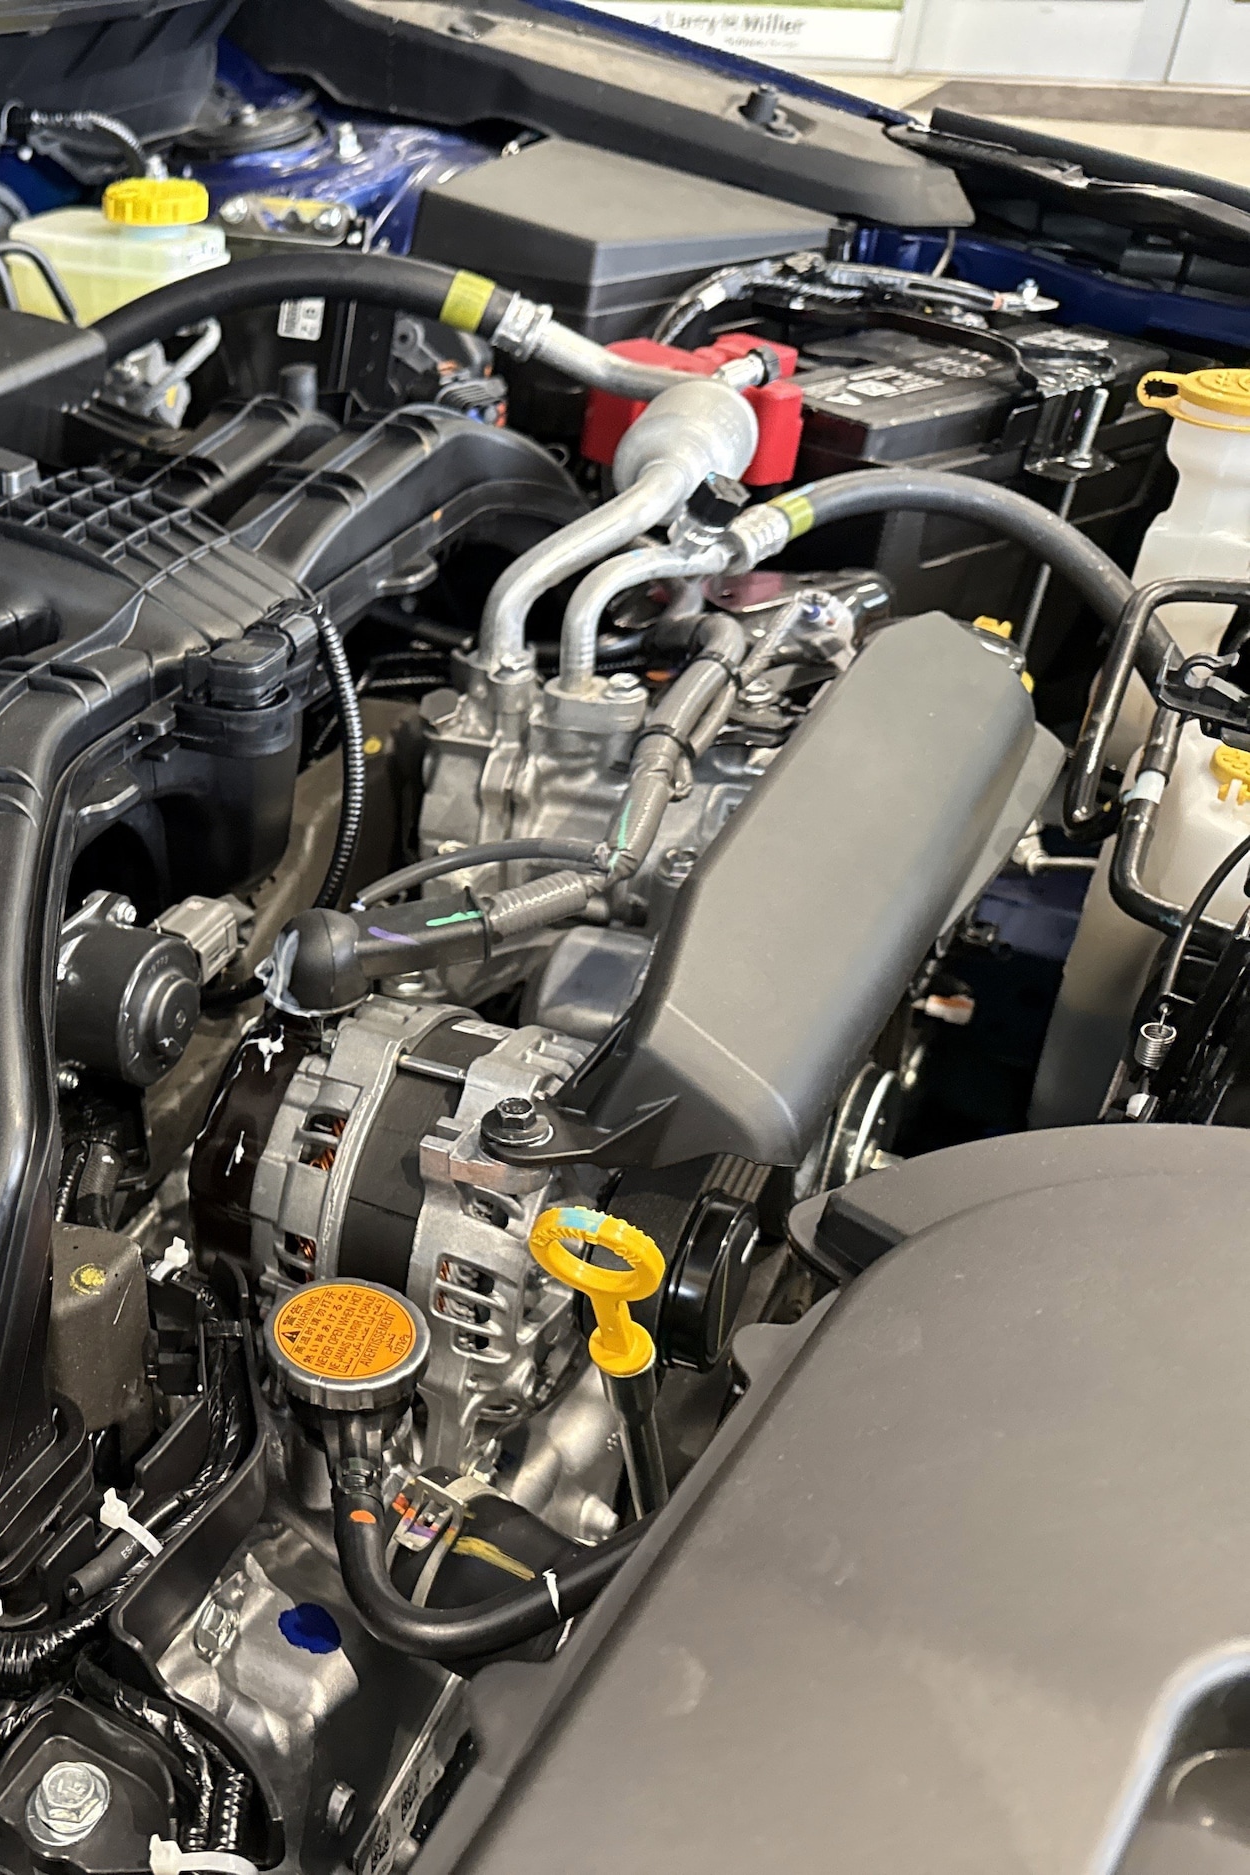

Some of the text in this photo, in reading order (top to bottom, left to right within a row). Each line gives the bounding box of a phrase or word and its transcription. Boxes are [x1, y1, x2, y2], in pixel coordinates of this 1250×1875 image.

[743, 13, 806, 35] Miller
[294, 1296, 320, 1331] WARNING
[314, 1345, 334, 1368] NEVER
[327, 1326, 345, 1345] OPEN
[337, 1305, 356, 1326] WHEN
[344, 1319, 363, 1341] OUVRIR
[359, 1311, 396, 1367] AVERTISSEMENT
[333, 1341, 352, 1362] JAMAIS
[327, 1361, 341, 1371] NE
